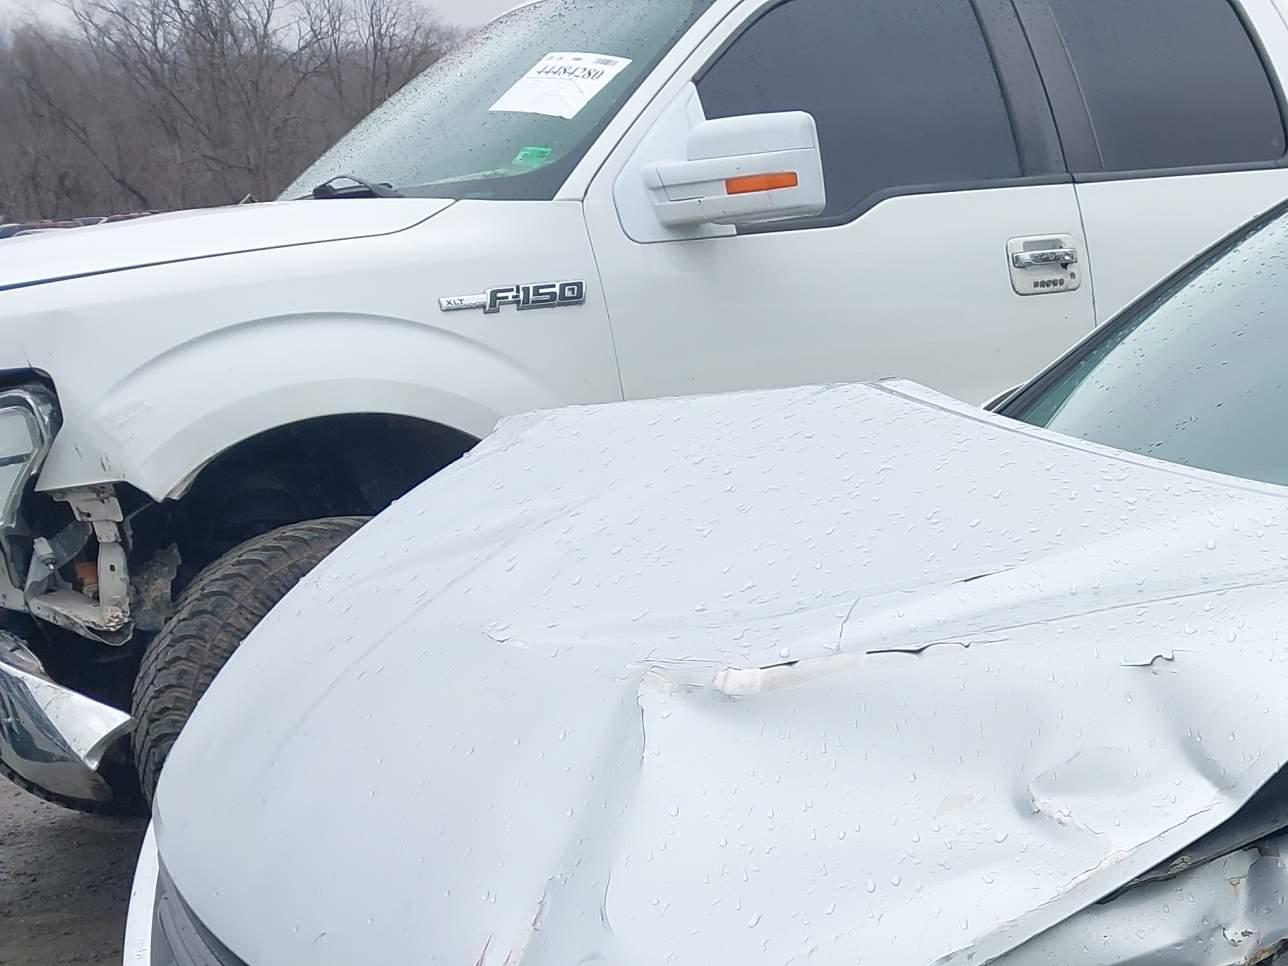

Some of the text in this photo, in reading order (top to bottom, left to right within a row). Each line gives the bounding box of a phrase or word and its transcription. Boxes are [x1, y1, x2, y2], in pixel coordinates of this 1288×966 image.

[536, 64, 605, 81] 44484280
[445, 280, 585, 311] XLT F-150
